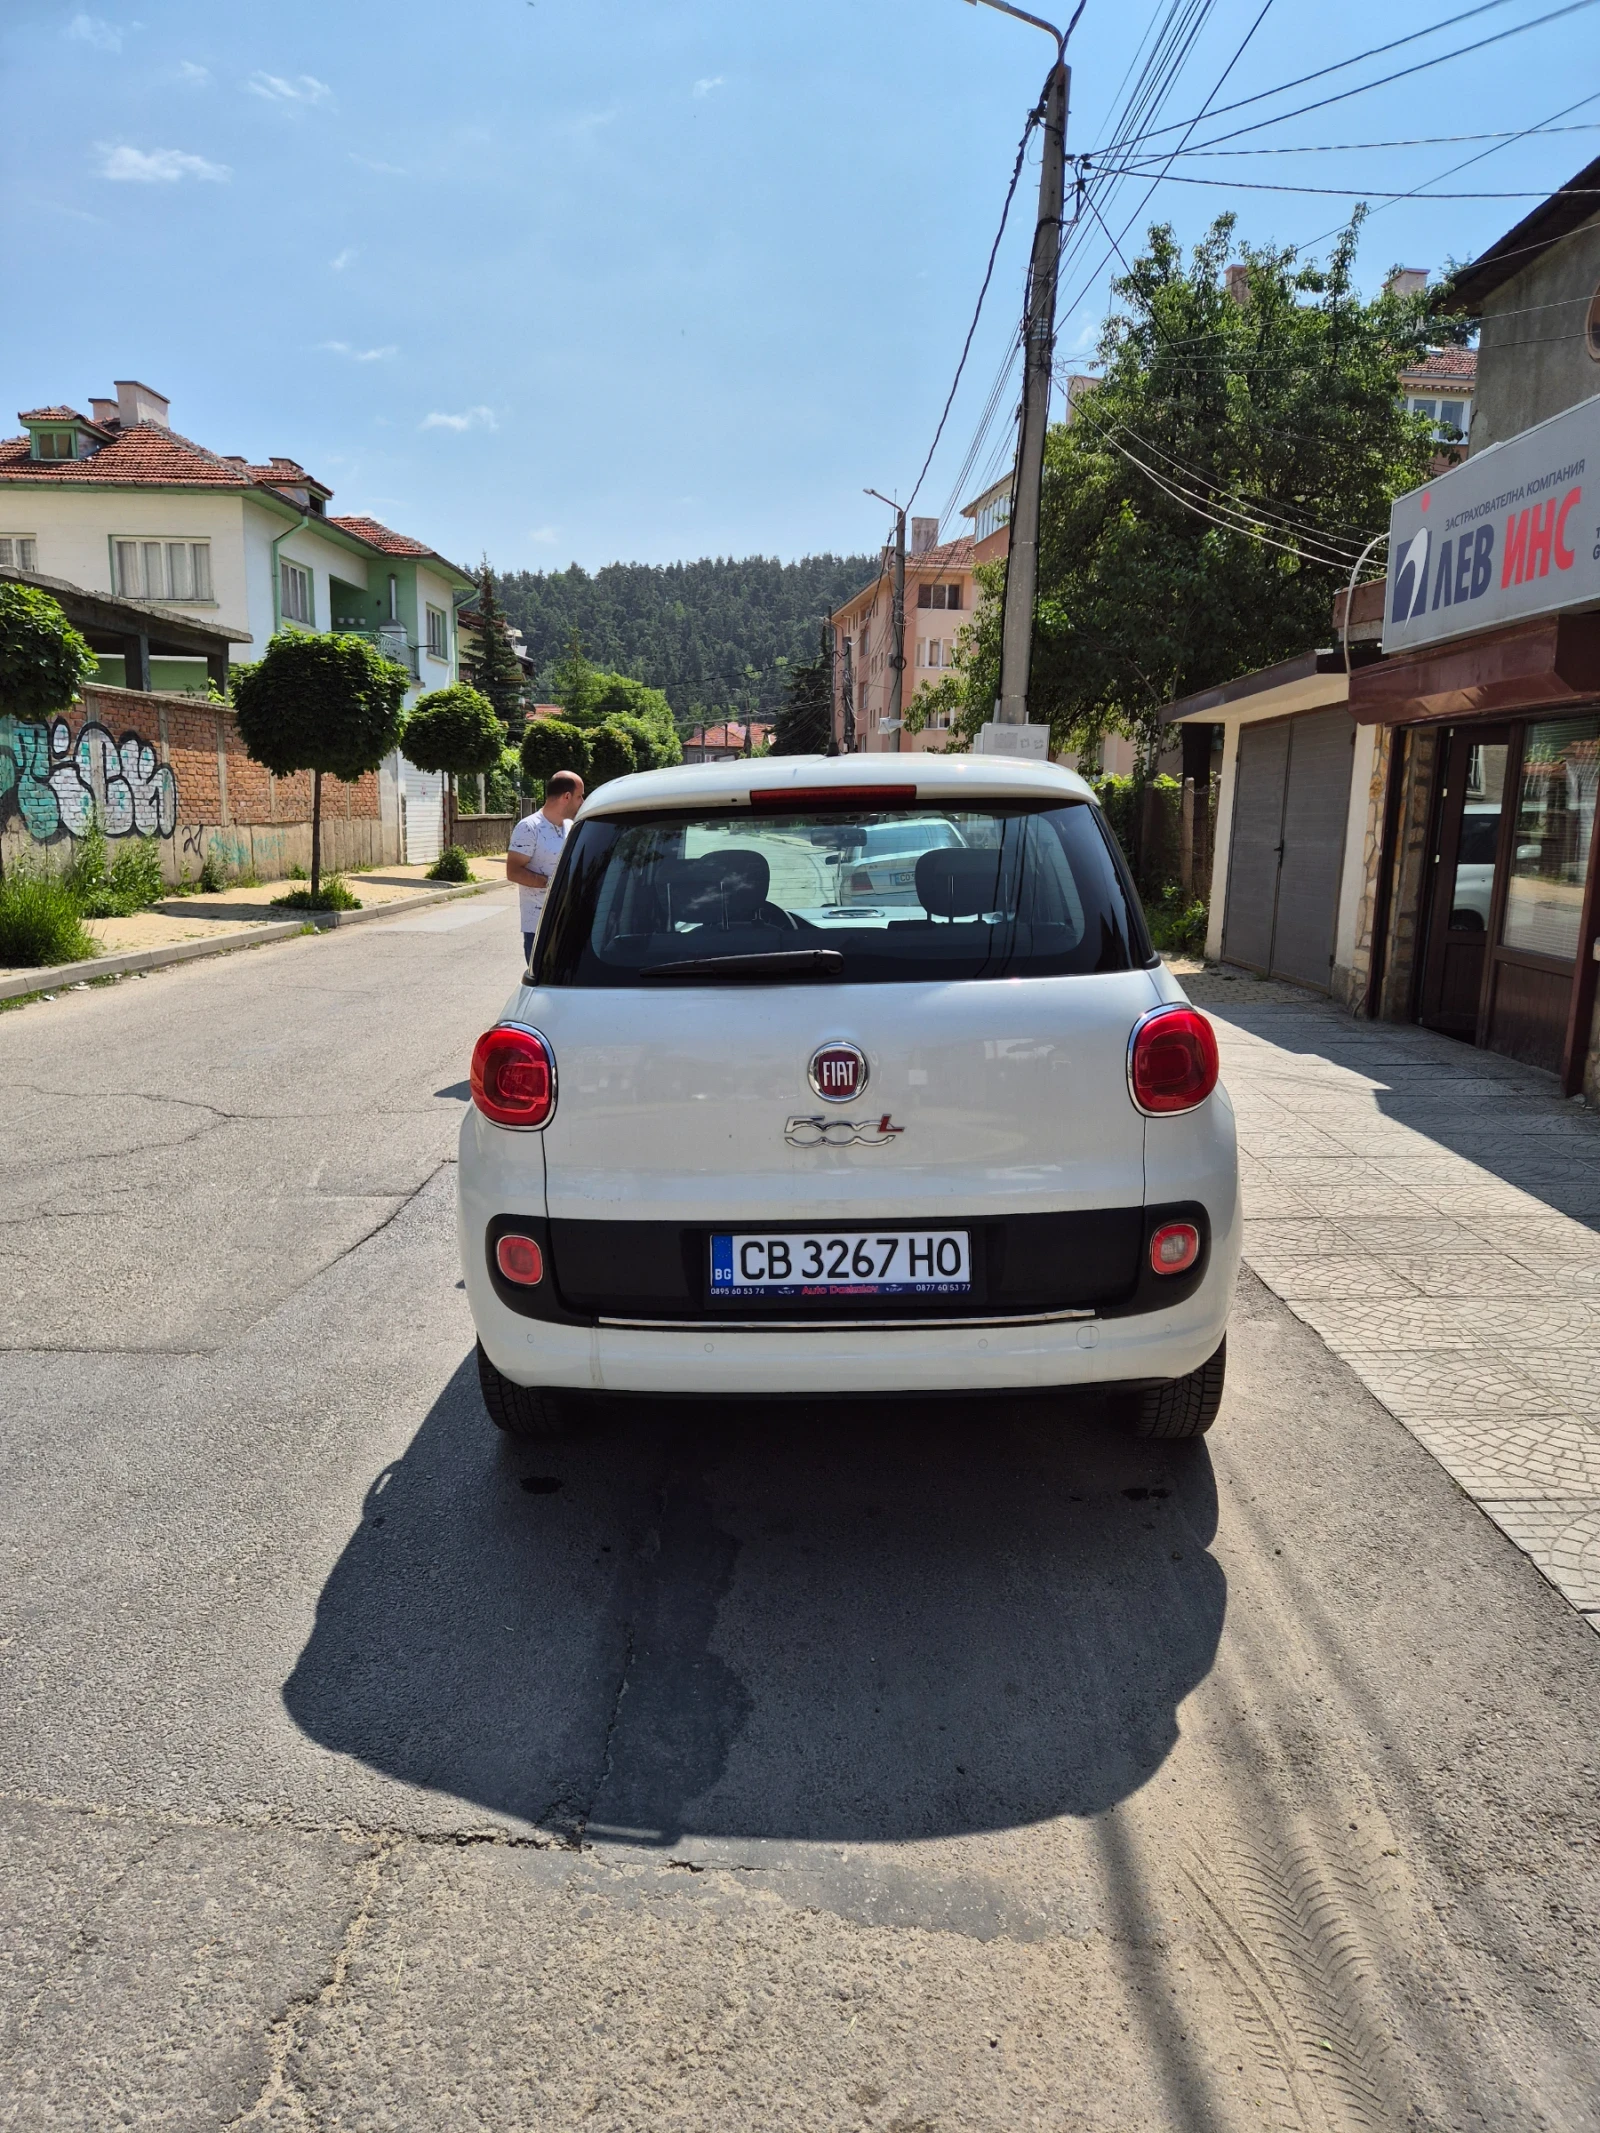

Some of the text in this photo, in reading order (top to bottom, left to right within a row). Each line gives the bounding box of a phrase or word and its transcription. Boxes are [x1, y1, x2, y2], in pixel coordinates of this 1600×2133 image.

[1445, 459, 1585, 532] ЗАСТРАХОВАТЕЛНА КОМПАНИЯ
[1432, 486, 1582, 611] ЛЕВ ИНС
[823, 1061, 855, 1087] FIAT
[740, 1241, 792, 1280] CB
[801, 1239, 899, 1279] 3267
[715, 1268, 732, 1280] BG
[710, 1287, 765, 1295] 0895 60 53 74
[801, 1286, 827, 1295] Auto
[916, 1283, 971, 1292] 0877 60 53 77
